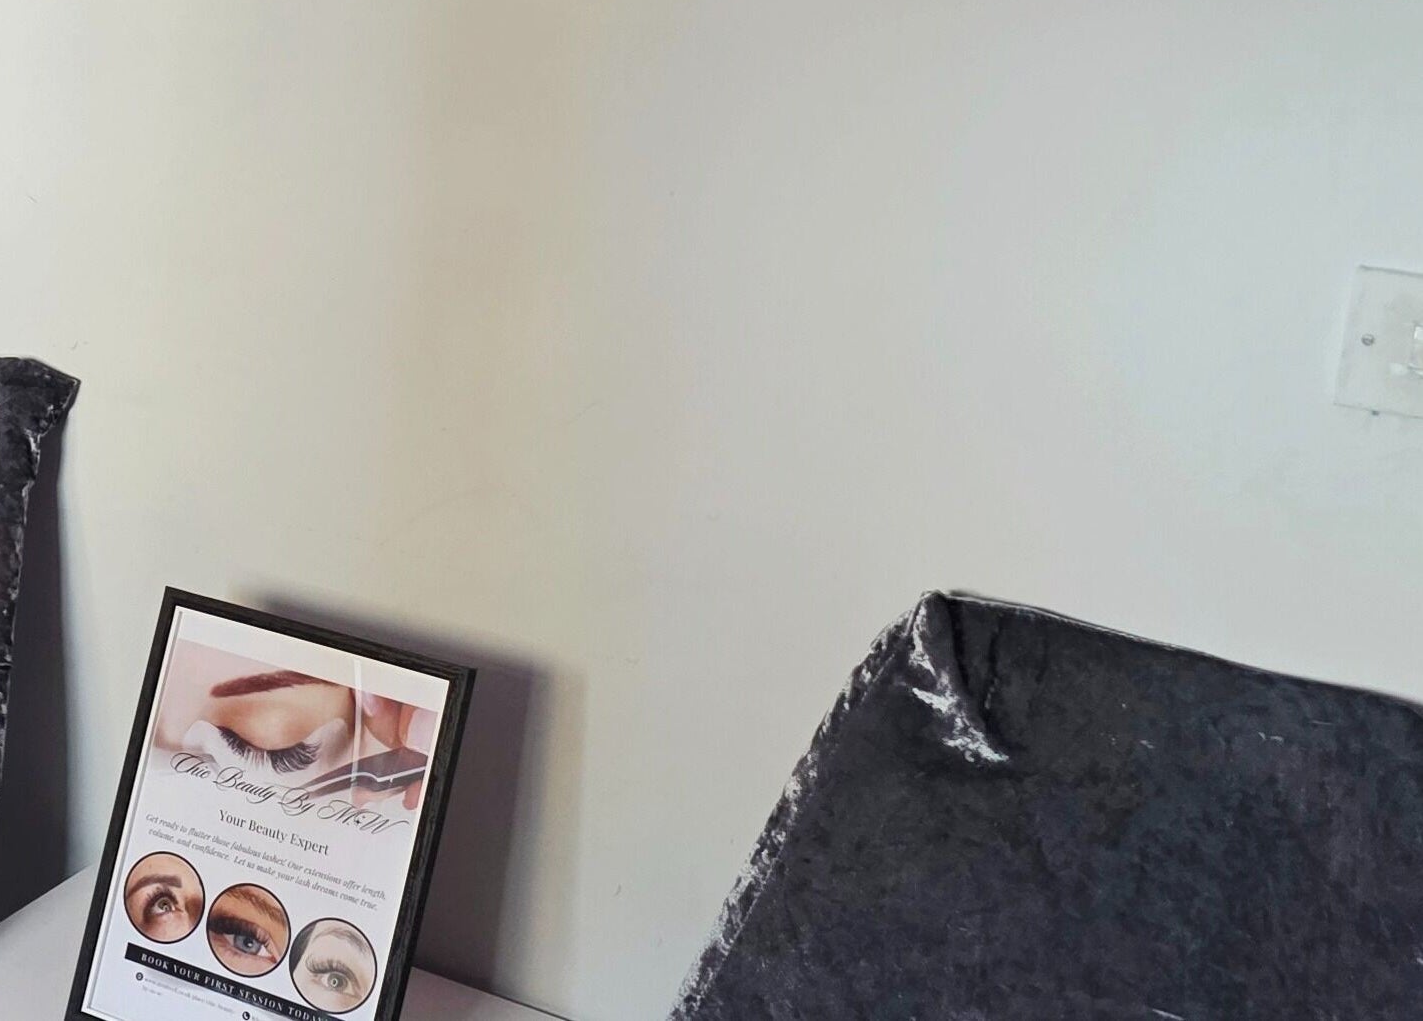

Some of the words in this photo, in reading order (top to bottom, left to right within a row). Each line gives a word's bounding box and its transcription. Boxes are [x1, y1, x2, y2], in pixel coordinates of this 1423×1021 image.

[170, 752, 210, 779] Chic
[212, 766, 277, 804] Beauty
[278, 787, 316, 816] By
[145, 813, 159, 822] Get
[158, 818, 179, 831] ready
[179, 824, 188, 832] to
[187, 827, 212, 840] flutter
[229, 841, 262, 857] fabulous
[287, 859, 303, 871] Our
[303, 867, 342, 885] extensions
[342, 878, 361, 891] offer
[219, 809, 247, 828] Your
[248, 819, 288, 843] Beauty
[290, 833, 329, 855] Expert
[176, 838, 191, 847] and
[233, 855, 245, 866] Let
[246, 861, 255, 869] us
[256, 865, 276, 876] make
[275, 871, 295, 881] your
[295, 876, 311, 888] lash
[311, 882, 339, 897] dreams
[339, 892, 359, 904] come
[141, 953, 169, 970] BOOK
[172, 964, 201, 981] YOUR
[204, 976, 235, 995] FIRST
[238, 989, 284, 1011] SESSION
